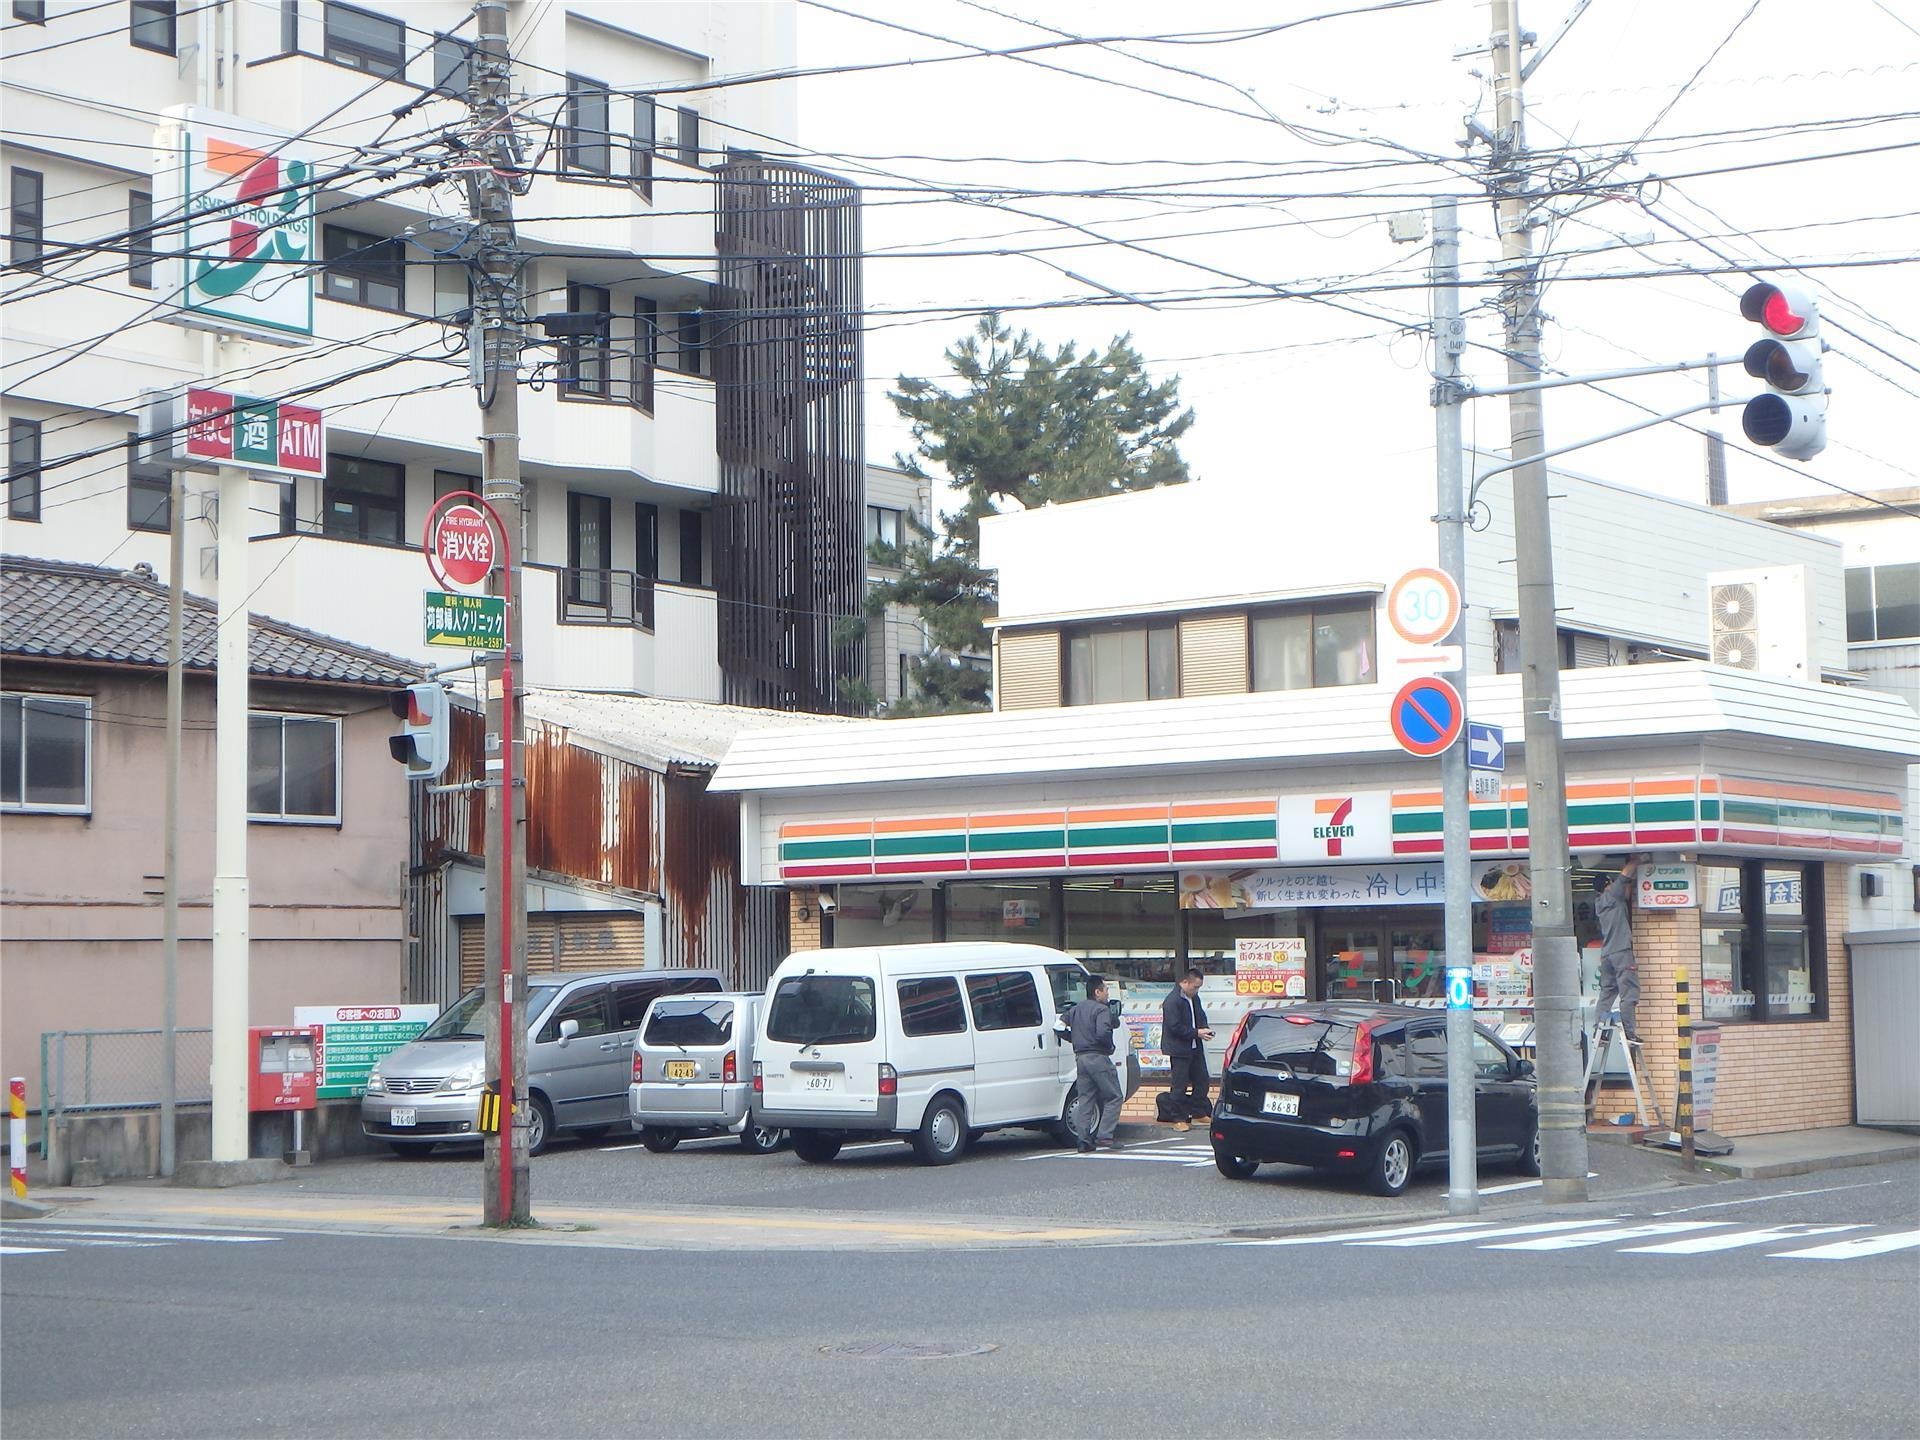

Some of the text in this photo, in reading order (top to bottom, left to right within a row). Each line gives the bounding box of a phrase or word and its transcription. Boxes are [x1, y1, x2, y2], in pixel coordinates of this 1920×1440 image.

[241, 411, 269, 451] 酒
[280, 418, 320, 459] ATM
[445, 516, 484, 528] FIRE HYDRANT
[441, 529, 490, 563] 消火栓
[1403, 588, 1443, 623] 30
[1255, 874, 1338, 886] ツルッとのど越し
[1365, 870, 1444, 899] 冷し中
[1255, 888, 1361, 902] 新しく生まれ変わった
[338, 1009, 400, 1020] お客様へのお願い
[674, 1068, 694, 1078] 42-43
[810, 1078, 832, 1089] 60-71
[1271, 1101, 1297, 1114] 86-83
[396, 1115, 415, 1124] 76-00
